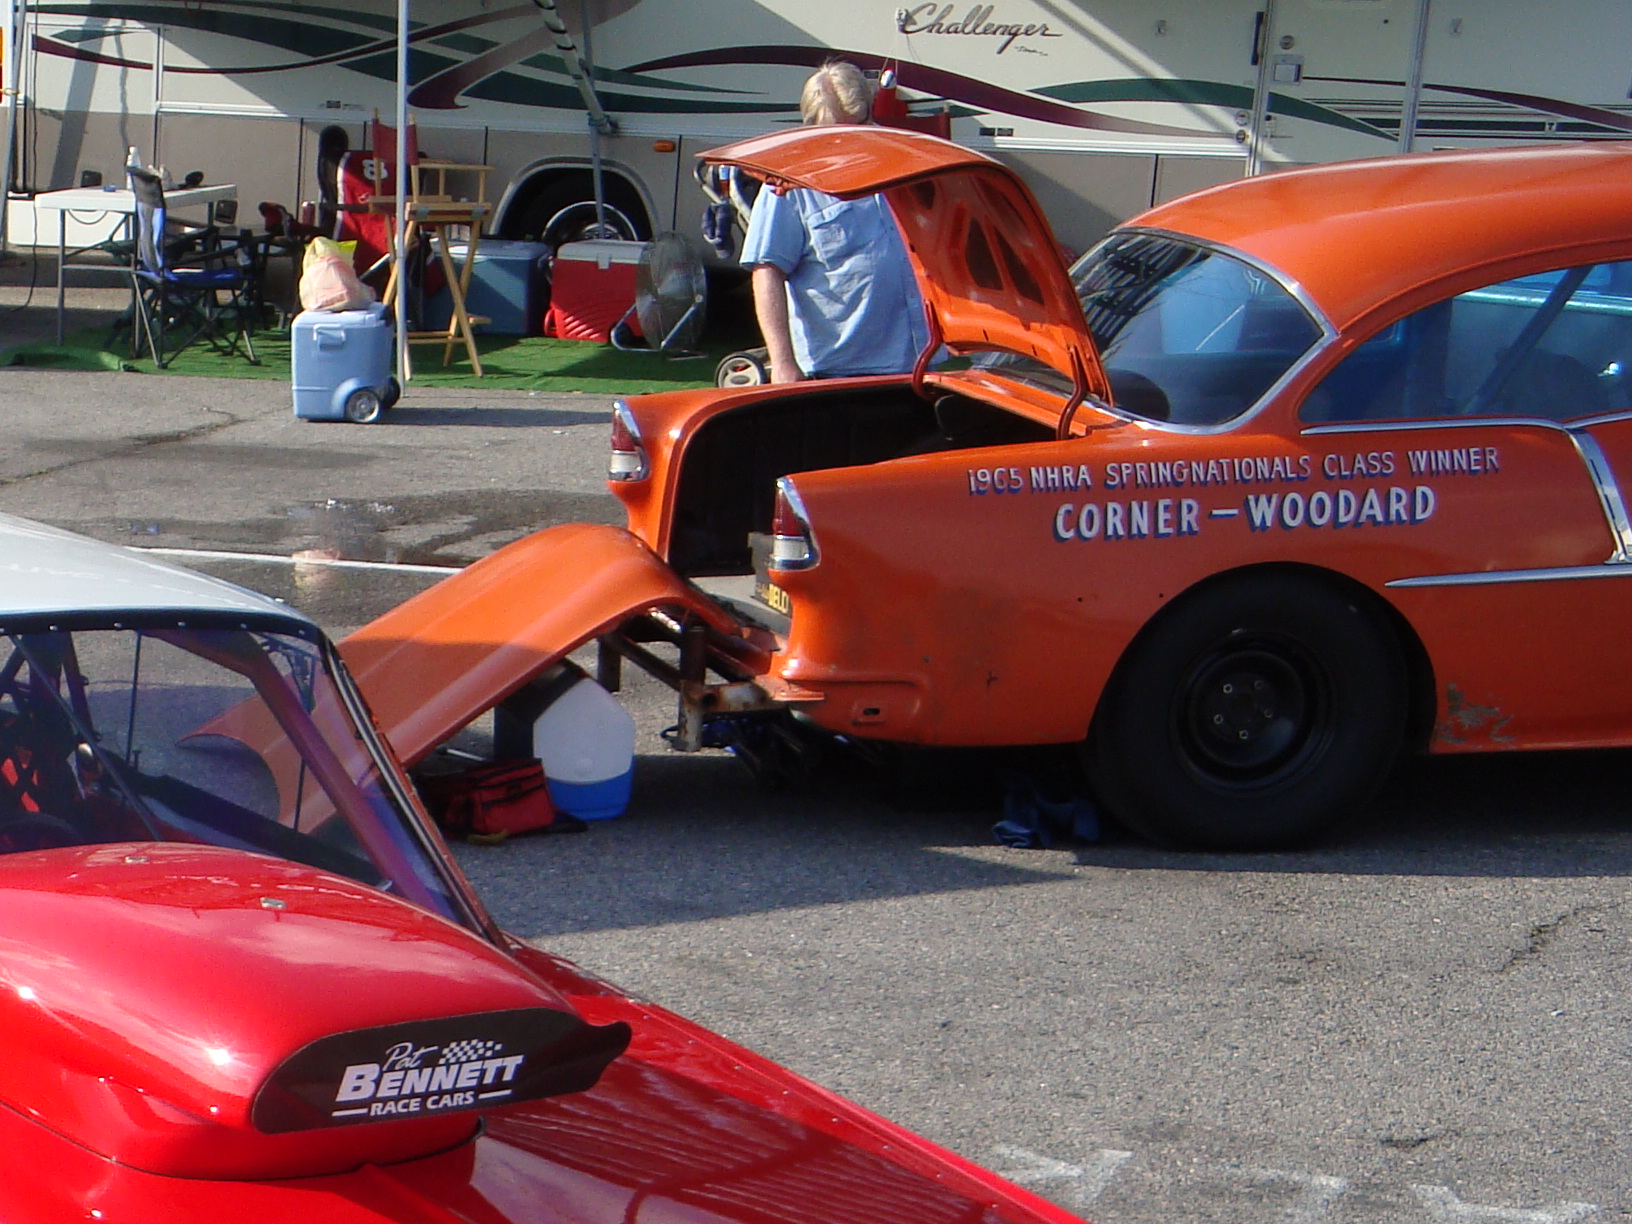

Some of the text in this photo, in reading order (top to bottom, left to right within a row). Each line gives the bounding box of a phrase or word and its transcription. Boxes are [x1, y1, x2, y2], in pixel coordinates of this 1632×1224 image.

[896, 3, 1063, 55] Challenger
[1030, 463, 1092, 489] NHRA
[1104, 454, 1311, 489] SPRINGNATIONALS
[1323, 451, 1395, 477] CLASS
[1407, 446, 1500, 474] WINNER
[1054, 498, 1200, 540] CORNER
[1247, 485, 1436, 529] WOODARD
[335, 1055, 525, 1102] BENNETT
[382, 1042, 439, 1072] Pat
[370, 1091, 475, 1116] RACE CARS
